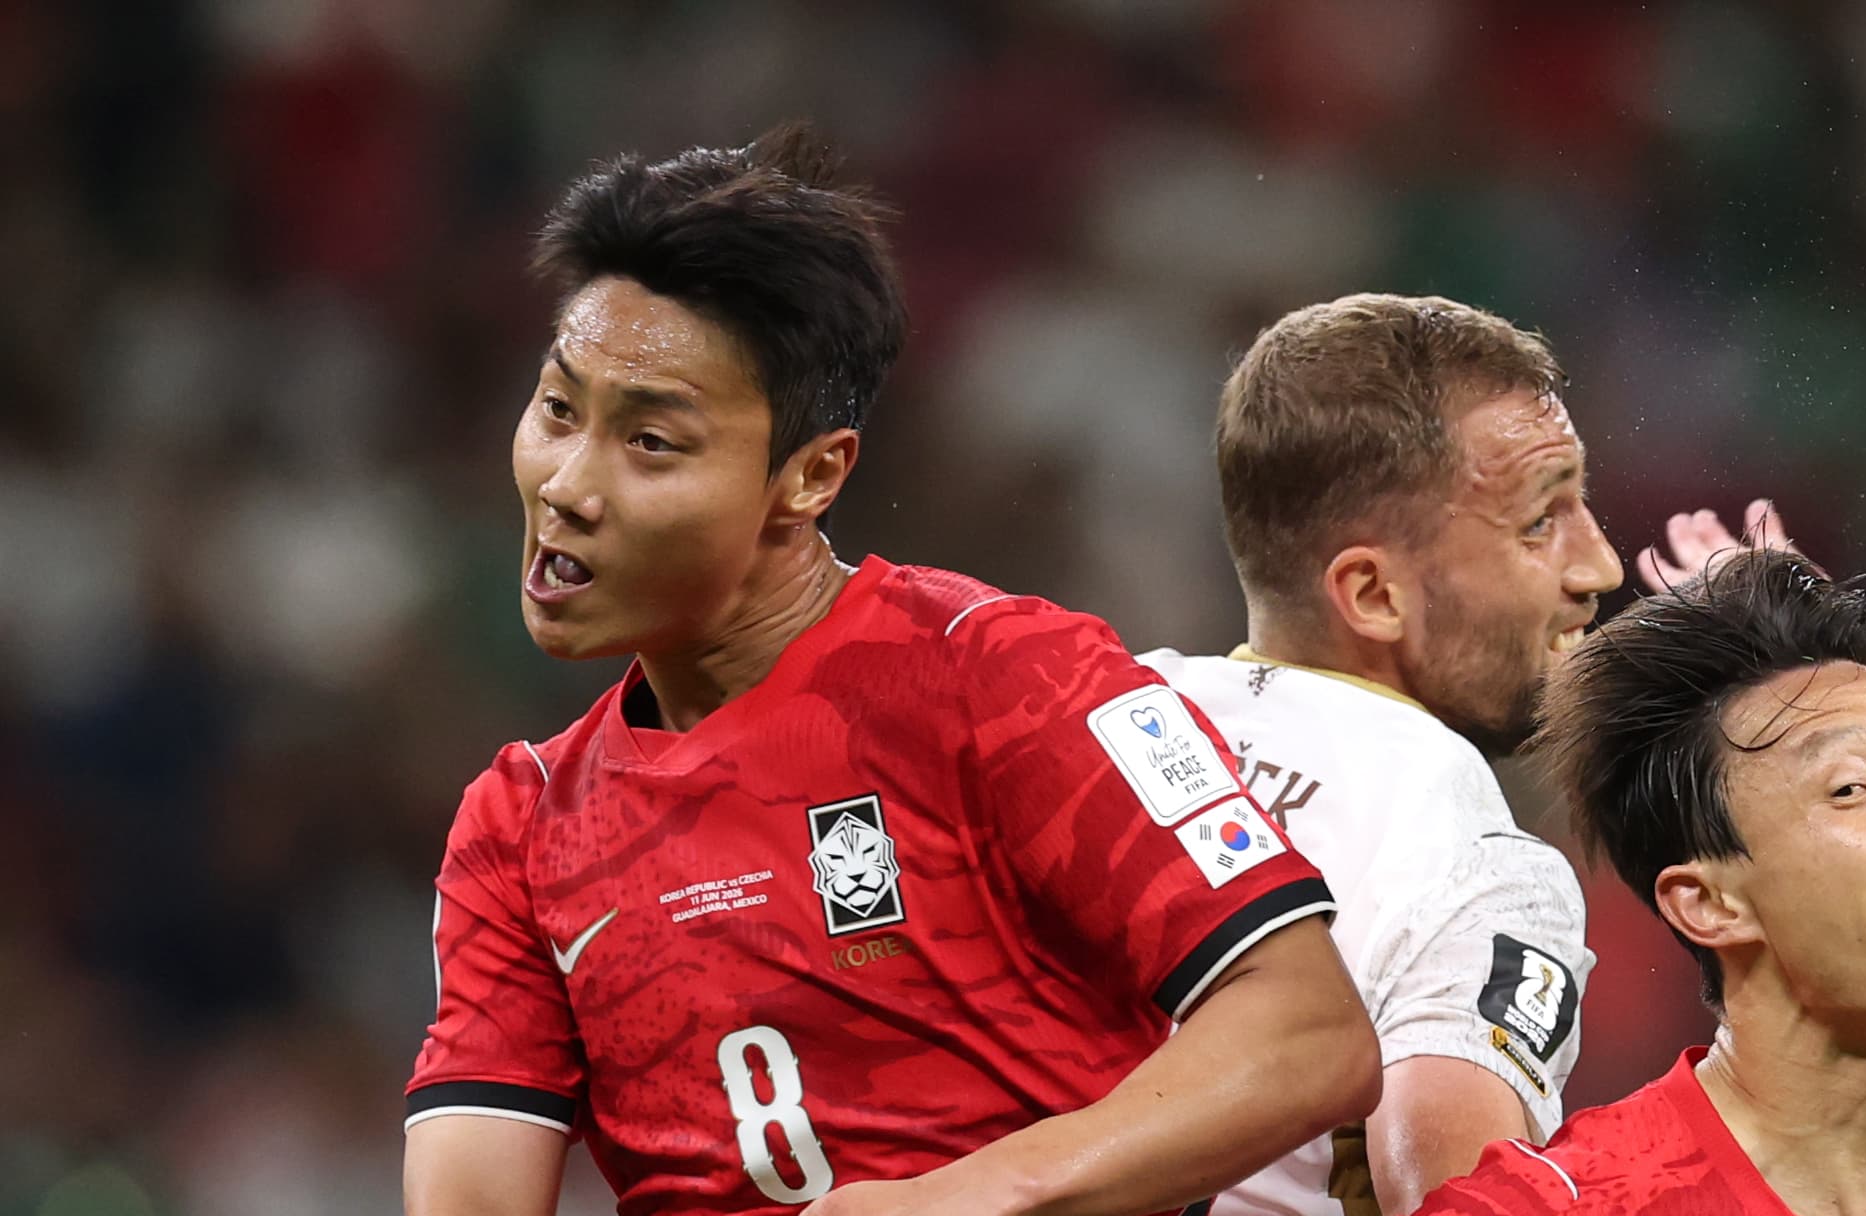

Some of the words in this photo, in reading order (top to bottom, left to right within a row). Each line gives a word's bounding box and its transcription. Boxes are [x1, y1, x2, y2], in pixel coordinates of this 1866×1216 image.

[1161, 754, 1207, 787] PEACE
[1184, 777, 1209, 795] FIFA
[660, 890, 686, 904] KOREA
[685, 880, 728, 896] REPUBLIC
[738, 870, 774, 885] CZECHIA
[690, 896, 700, 906] 11
[701, 891, 721, 904] JUN
[721, 888, 744, 900] 2026
[672, 901, 733, 923] GUADALAJARA,
[732, 894, 768, 909] MEXICO
[716, 1024, 835, 1205] 8
